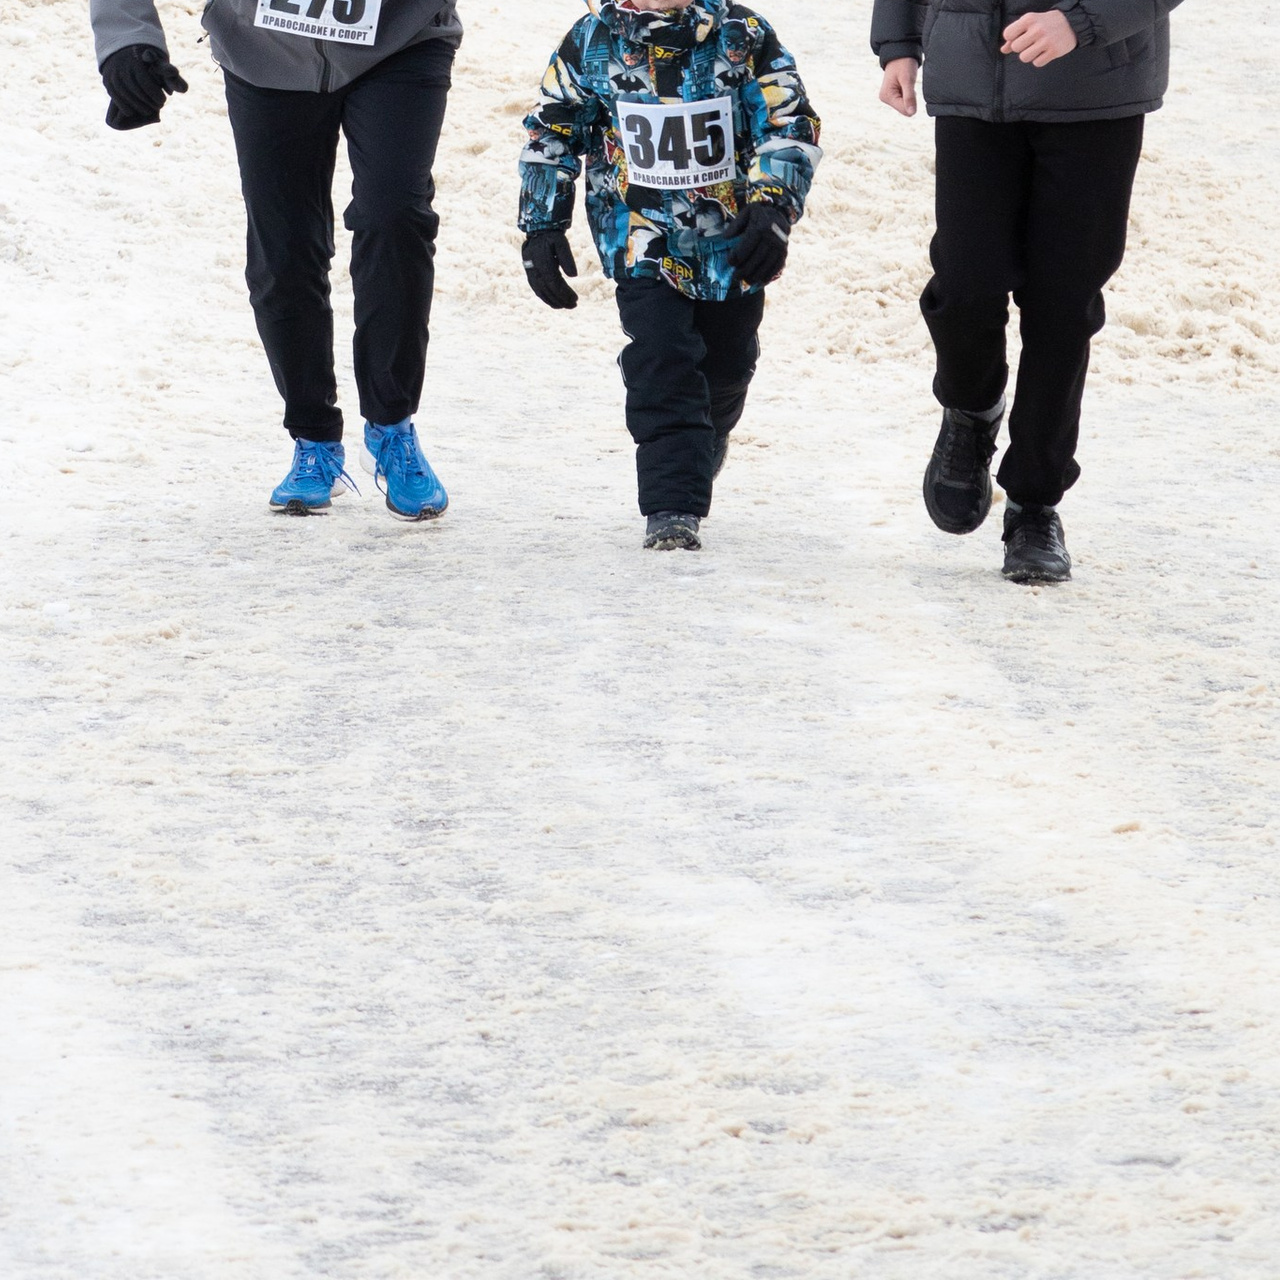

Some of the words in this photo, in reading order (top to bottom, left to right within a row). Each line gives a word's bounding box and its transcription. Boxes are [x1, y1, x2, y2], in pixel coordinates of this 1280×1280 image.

[262, 14, 328, 37] ПРАВОСЛАВИЕ
[329, 28, 336, 38] И
[338, 28, 368, 42] СПОРТ
[625, 110, 726, 170] 345
[633, 171, 692, 186] ПРАВОСЛАВИЕ
[693, 175, 700, 184] И
[701, 167, 729, 184] СПОРТ
